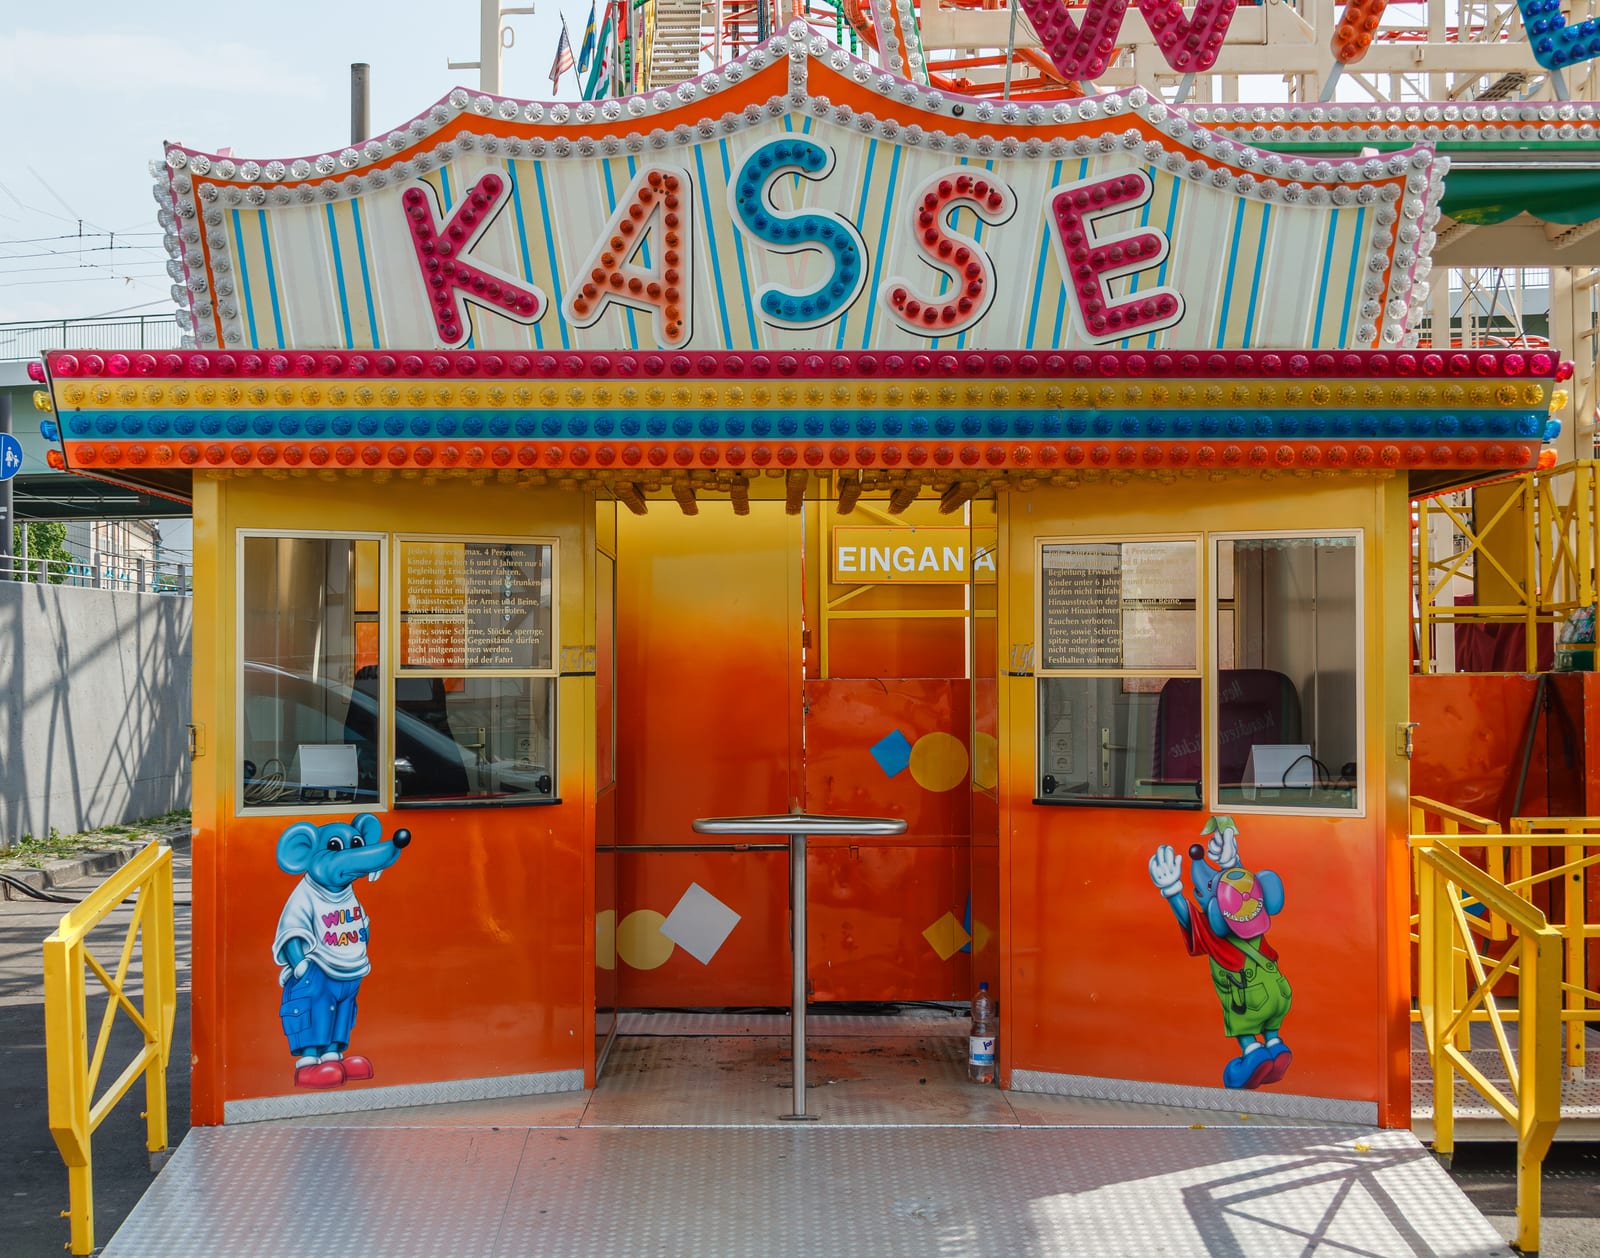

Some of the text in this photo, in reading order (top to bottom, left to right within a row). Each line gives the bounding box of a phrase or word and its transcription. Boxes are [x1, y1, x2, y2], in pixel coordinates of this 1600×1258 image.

[402, 138, 1182, 347] KASSE
[491, 548, 527, 557] Personen.
[408, 557, 432, 565] Kinder
[499, 559, 523, 567] Jahren
[838, 546, 964, 572] EINGAN
[408, 567, 446, 576] Begleitung
[495, 568, 521, 576] fahren.
[1048, 567, 1087, 577] Begleitung
[408, 577, 433, 585] Kinder
[463, 578, 486, 586] ahren
[1048, 578, 1073, 586] Kinder
[1102, 578, 1126, 587] Jahre
[408, 586, 433, 594] dürfen
[454, 587, 493, 595] miahren.
[1048, 587, 1072, 595] dürfen
[1074, 587, 1093, 595] nicht
[408, 597, 464, 605] nausstrecken
[518, 598, 540, 606] Beine,
[1048, 598, 1103, 606] Hinausstrecken
[1105, 597, 1118, 606] der
[1048, 607, 1070, 615] sowie
[1048, 617, 1116, 625] Rauchen verboten.
[431, 627, 452, 635] sowie
[487, 627, 513, 636] Stöcke,
[1049, 628, 1069, 636] Tiere,
[1070, 628, 1092, 636] sowie
[1093, 627, 1126, 636] Schirme
[450, 636, 466, 644] lose
[467, 636, 514, 646] Gegenstände
[515, 636, 540, 644] dürfen
[1048, 637, 1070, 646] spitze
[1090, 636, 1105, 644] lose
[408, 645, 426, 653] nicht
[1068, 645, 1121, 655] mitgenommen
[408, 656, 445, 664] Festhalten
[480, 656, 494, 664] der
[495, 656, 514, 664] Fahrt
[1048, 656, 1119, 664] Festhalten während
[321, 906, 362, 929] WILD
[322, 927, 368, 947] MAUS
